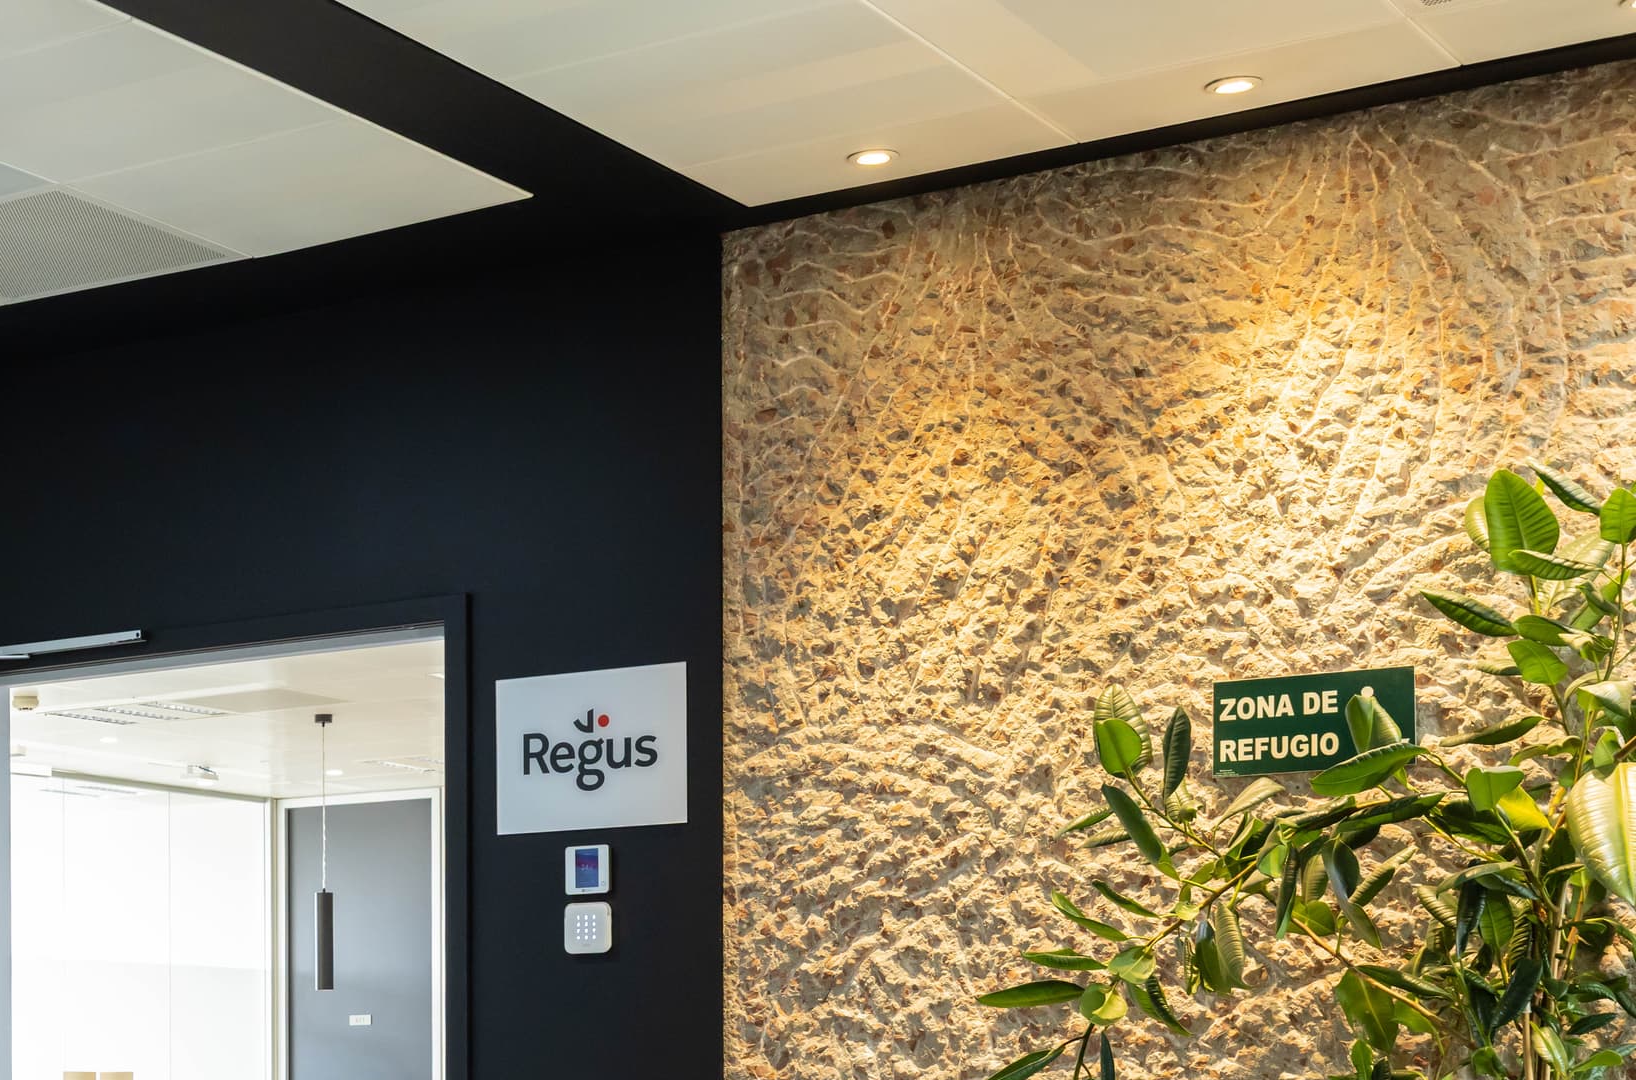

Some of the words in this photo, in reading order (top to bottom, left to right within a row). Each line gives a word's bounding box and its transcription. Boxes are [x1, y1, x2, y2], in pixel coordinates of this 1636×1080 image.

[1219, 694, 1294, 722] ZONA
[1302, 690, 1338, 716] DE
[523, 732, 658, 791] Regus
[1219, 732, 1340, 763] REFUGIO
